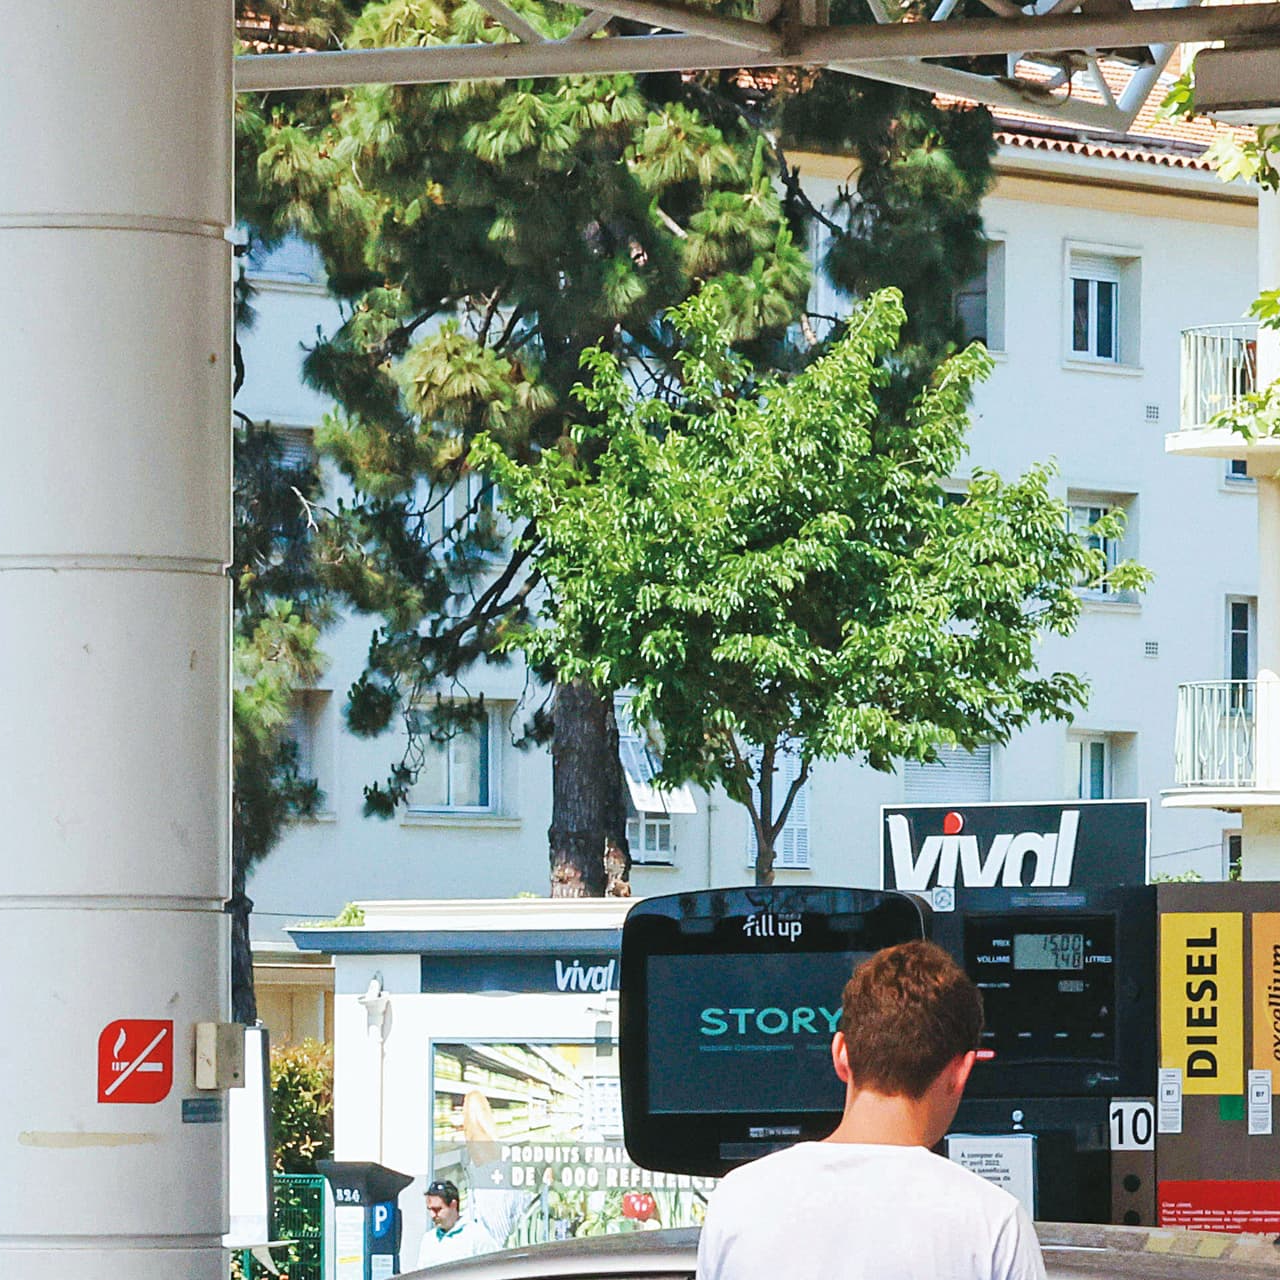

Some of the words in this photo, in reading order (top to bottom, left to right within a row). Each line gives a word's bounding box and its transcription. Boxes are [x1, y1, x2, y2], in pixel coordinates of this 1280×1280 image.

[886, 810, 1080, 891] Vival
[743, 914, 775, 937] fill
[778, 921, 803, 942] up
[555, 959, 616, 991] Vival
[1186, 927, 1218, 1078] DIESEL
[700, 1007, 843, 1036] STORY
[1112, 1107, 1152, 1146] 10
[501, 1146, 580, 1163] PRODUITS
[511, 1167, 535, 1186] DE
[543, 1168, 554, 1187] 4
[561, 1167, 599, 1187] 000
[375, 1205, 388, 1232] P
